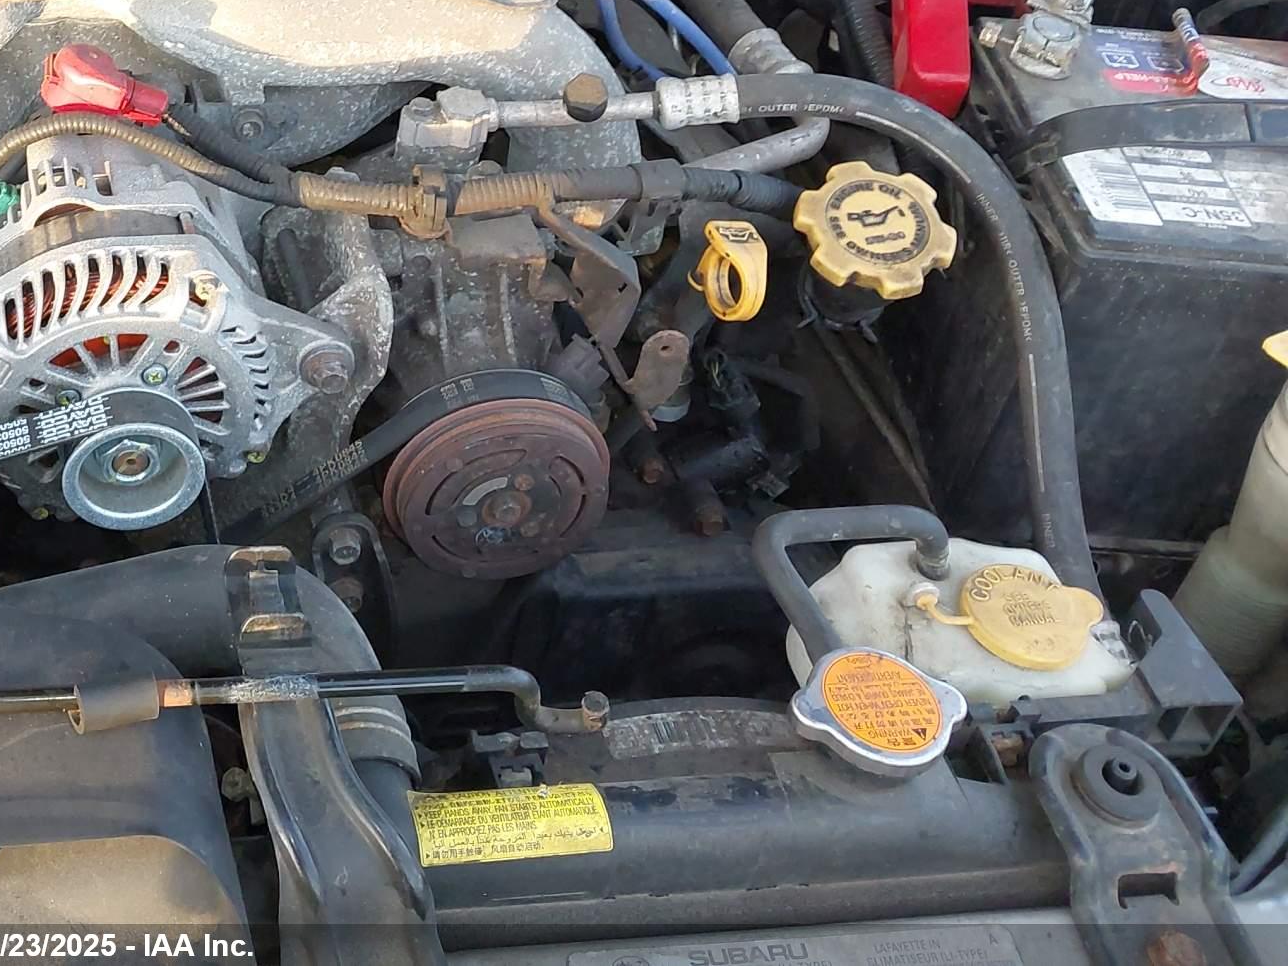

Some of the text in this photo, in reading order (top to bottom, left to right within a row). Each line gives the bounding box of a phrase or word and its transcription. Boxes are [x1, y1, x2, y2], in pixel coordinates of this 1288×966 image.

[758, 103, 798, 113] OUTER
[830, 182, 902, 210] ENGINE OIL
[976, 193, 1000, 223] INNER
[1008, 259, 1026, 296] OUTER
[39, 403, 107, 429] DAYCO
[42, 413, 109, 439] DAYCO
[837, 704, 853, 712] HOT
[882, 699, 904, 710] OPEN
[905, 698, 932, 707] NEVER
[868, 729, 913, 739] WARNING
[424, 810, 442, 820] KEEP
[445, 808, 470, 819] HANDS
[494, 803, 509, 813] FAN
[510, 801, 538, 812] STARTS
[489, 810, 532, 824] VENTILATEUR
[488, 823, 501, 834] PAS
[874, 938, 941, 954] LAFAYETTE IN
[988, 933, 999, 946] A
[687, 942, 810, 966] SUBARU
